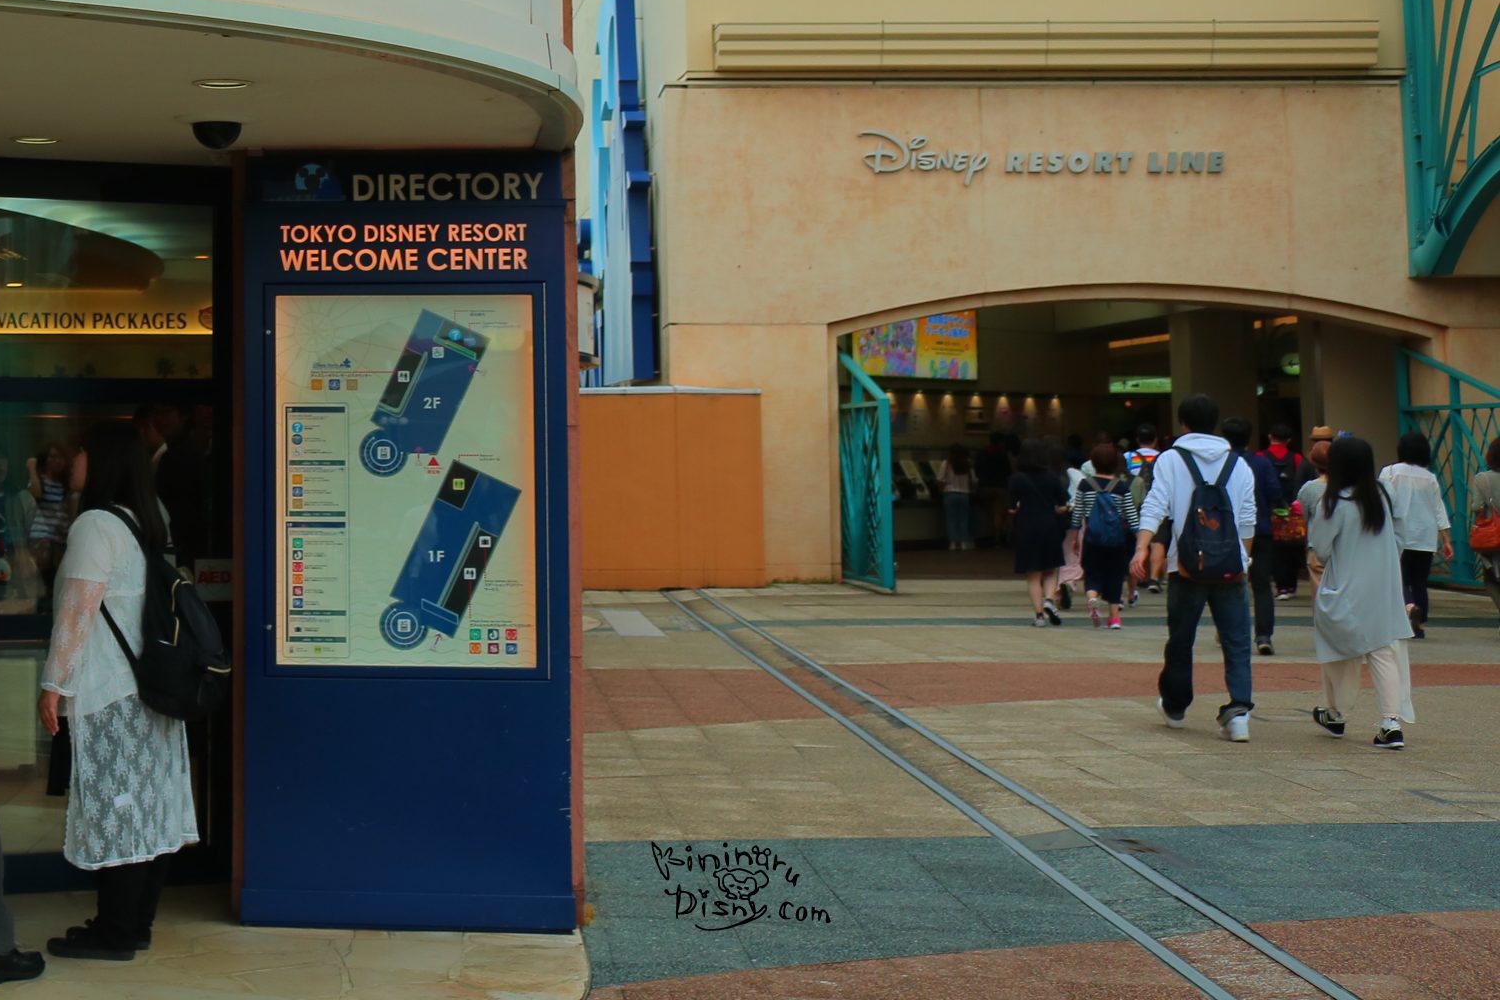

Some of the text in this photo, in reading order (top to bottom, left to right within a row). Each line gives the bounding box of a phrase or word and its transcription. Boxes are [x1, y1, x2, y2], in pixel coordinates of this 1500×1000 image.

[1004, 151, 1134, 175] RESORT
[1147, 150, 1226, 175] LINE
[352, 172, 544, 202] DIRECTORY
[280, 223, 528, 244] TOKYO DISNEY RESORT
[279, 247, 529, 272] WELCOME CENTER
[91, 312, 188, 331] PACKAGES
[422, 396, 442, 410] 2F
[427, 550, 446, 563] 1F
[197, 570, 231, 585] AED
